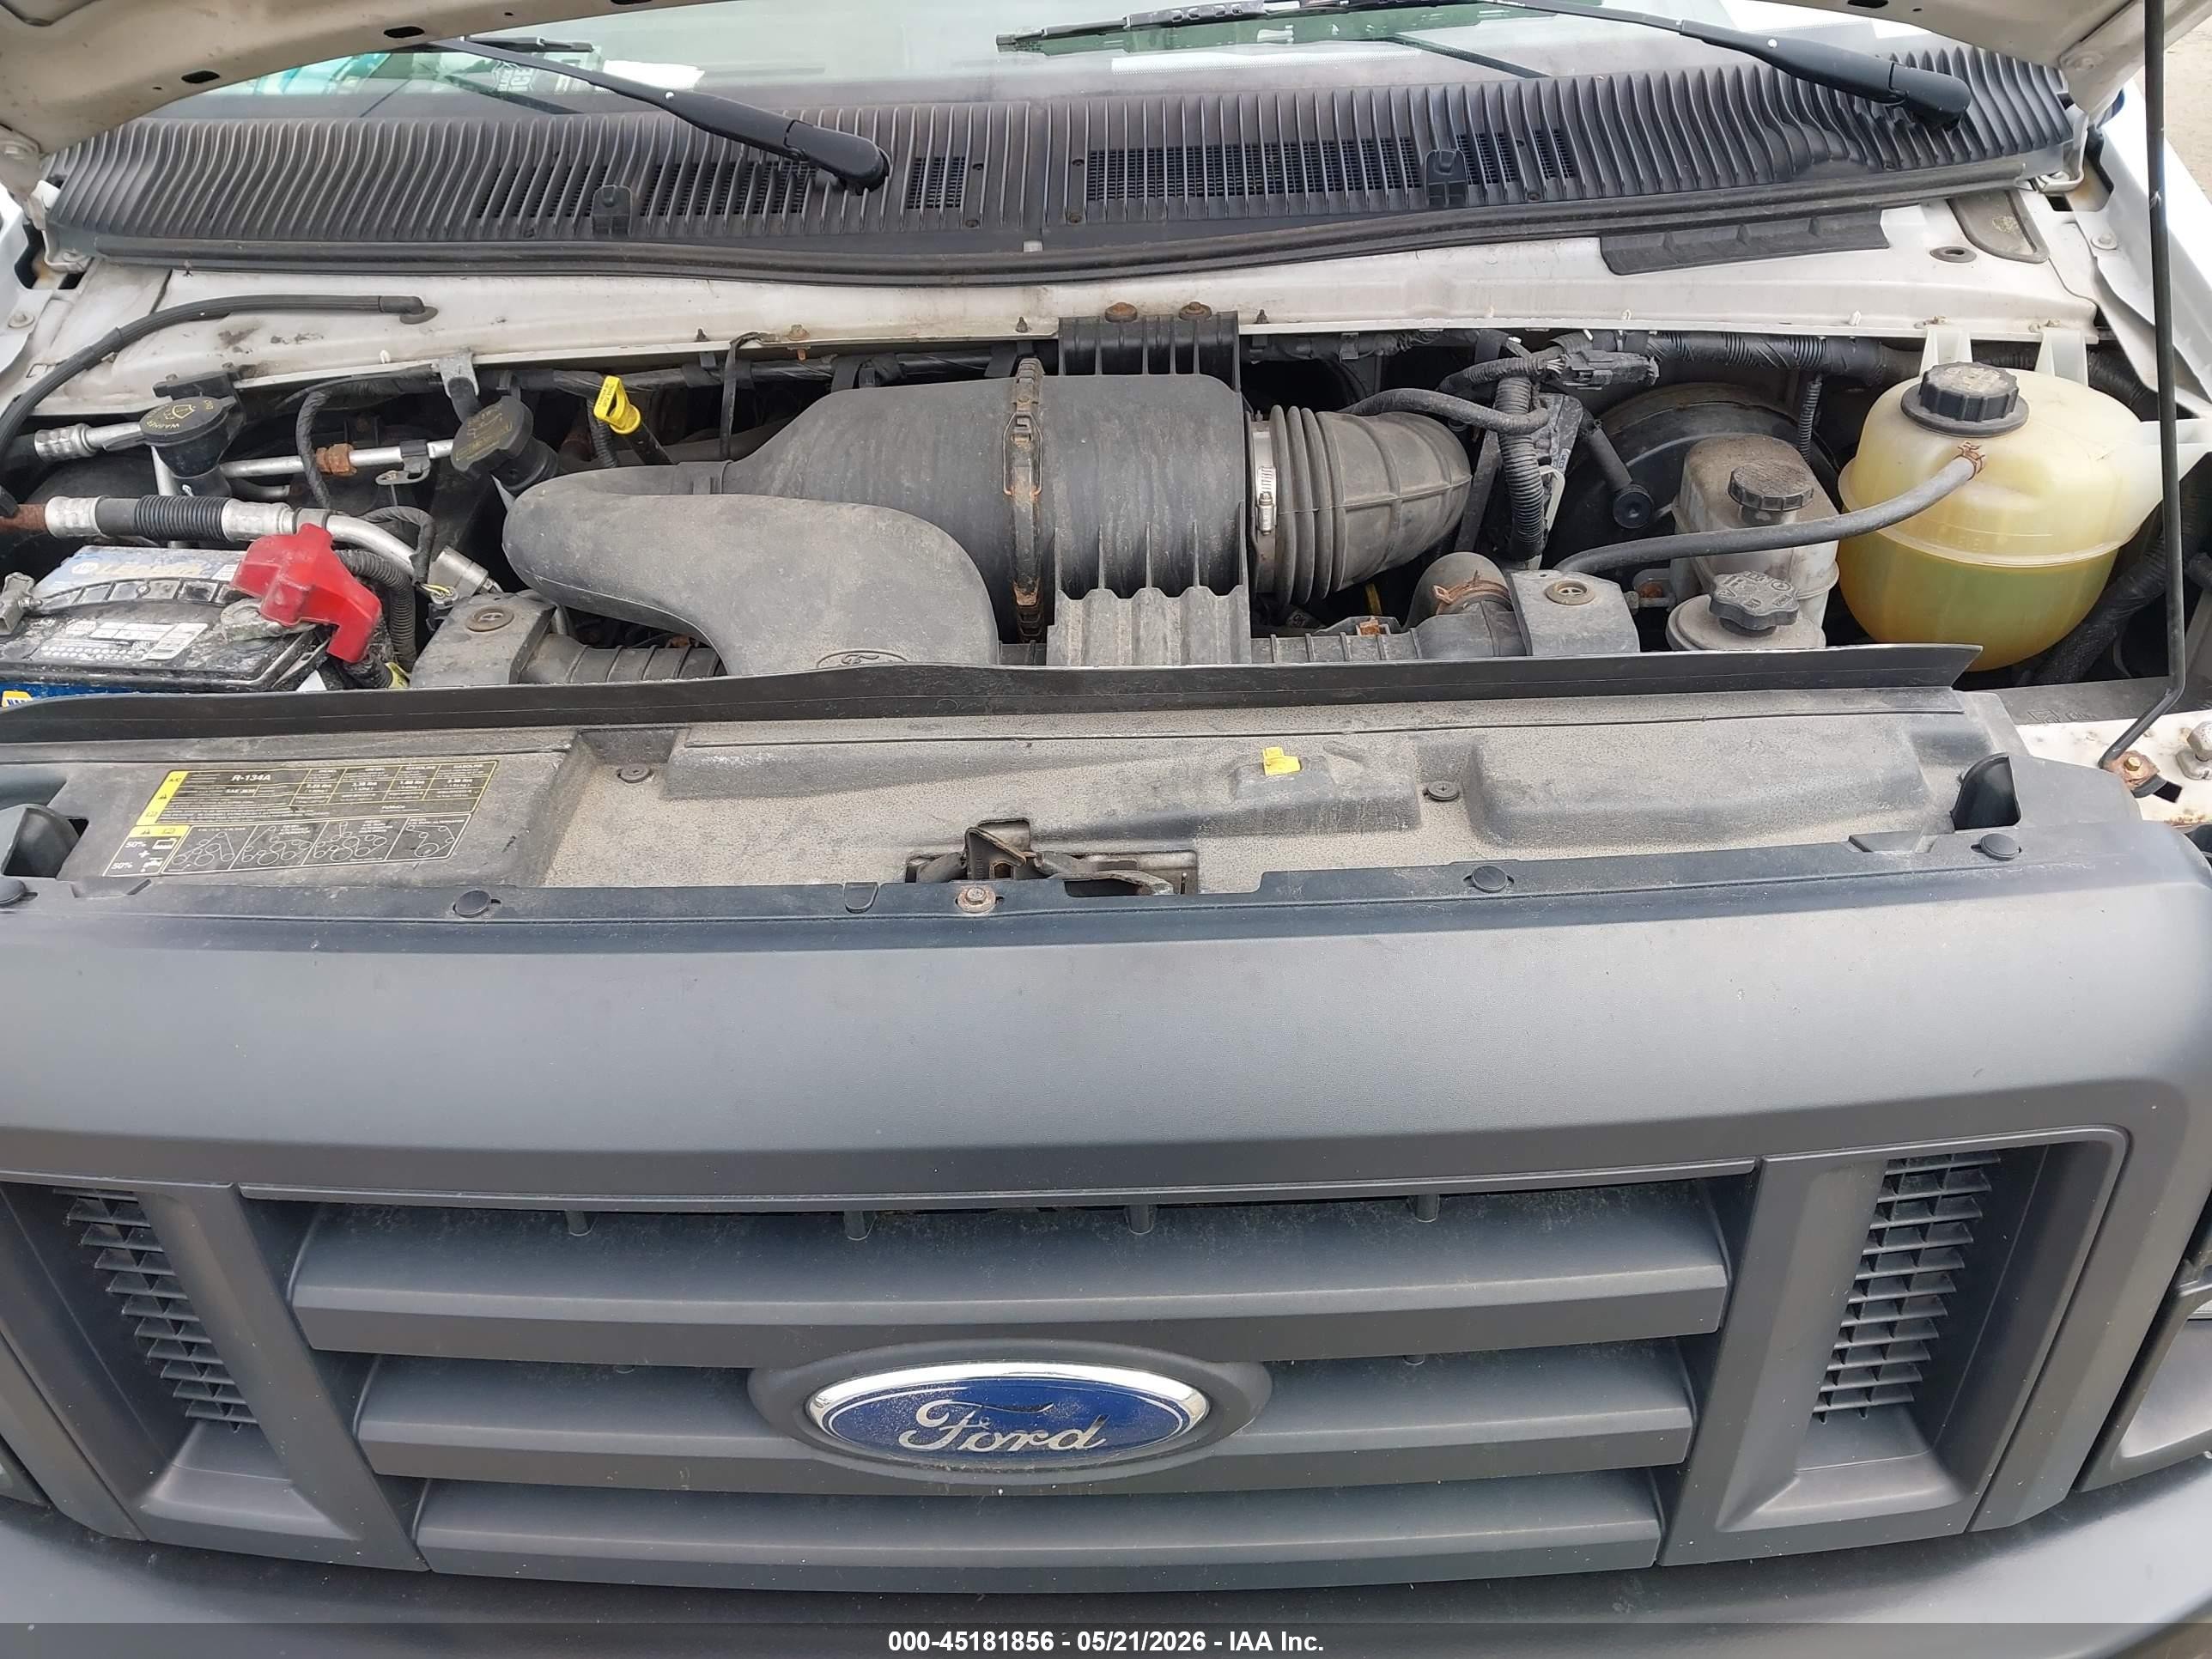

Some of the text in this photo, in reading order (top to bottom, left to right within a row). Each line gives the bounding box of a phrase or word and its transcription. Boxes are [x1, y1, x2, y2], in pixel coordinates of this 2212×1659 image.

[508, 68, 533, 92] ICE
[111, 860, 133, 869] 50%
[898, 1399, 1108, 1453] Ford
